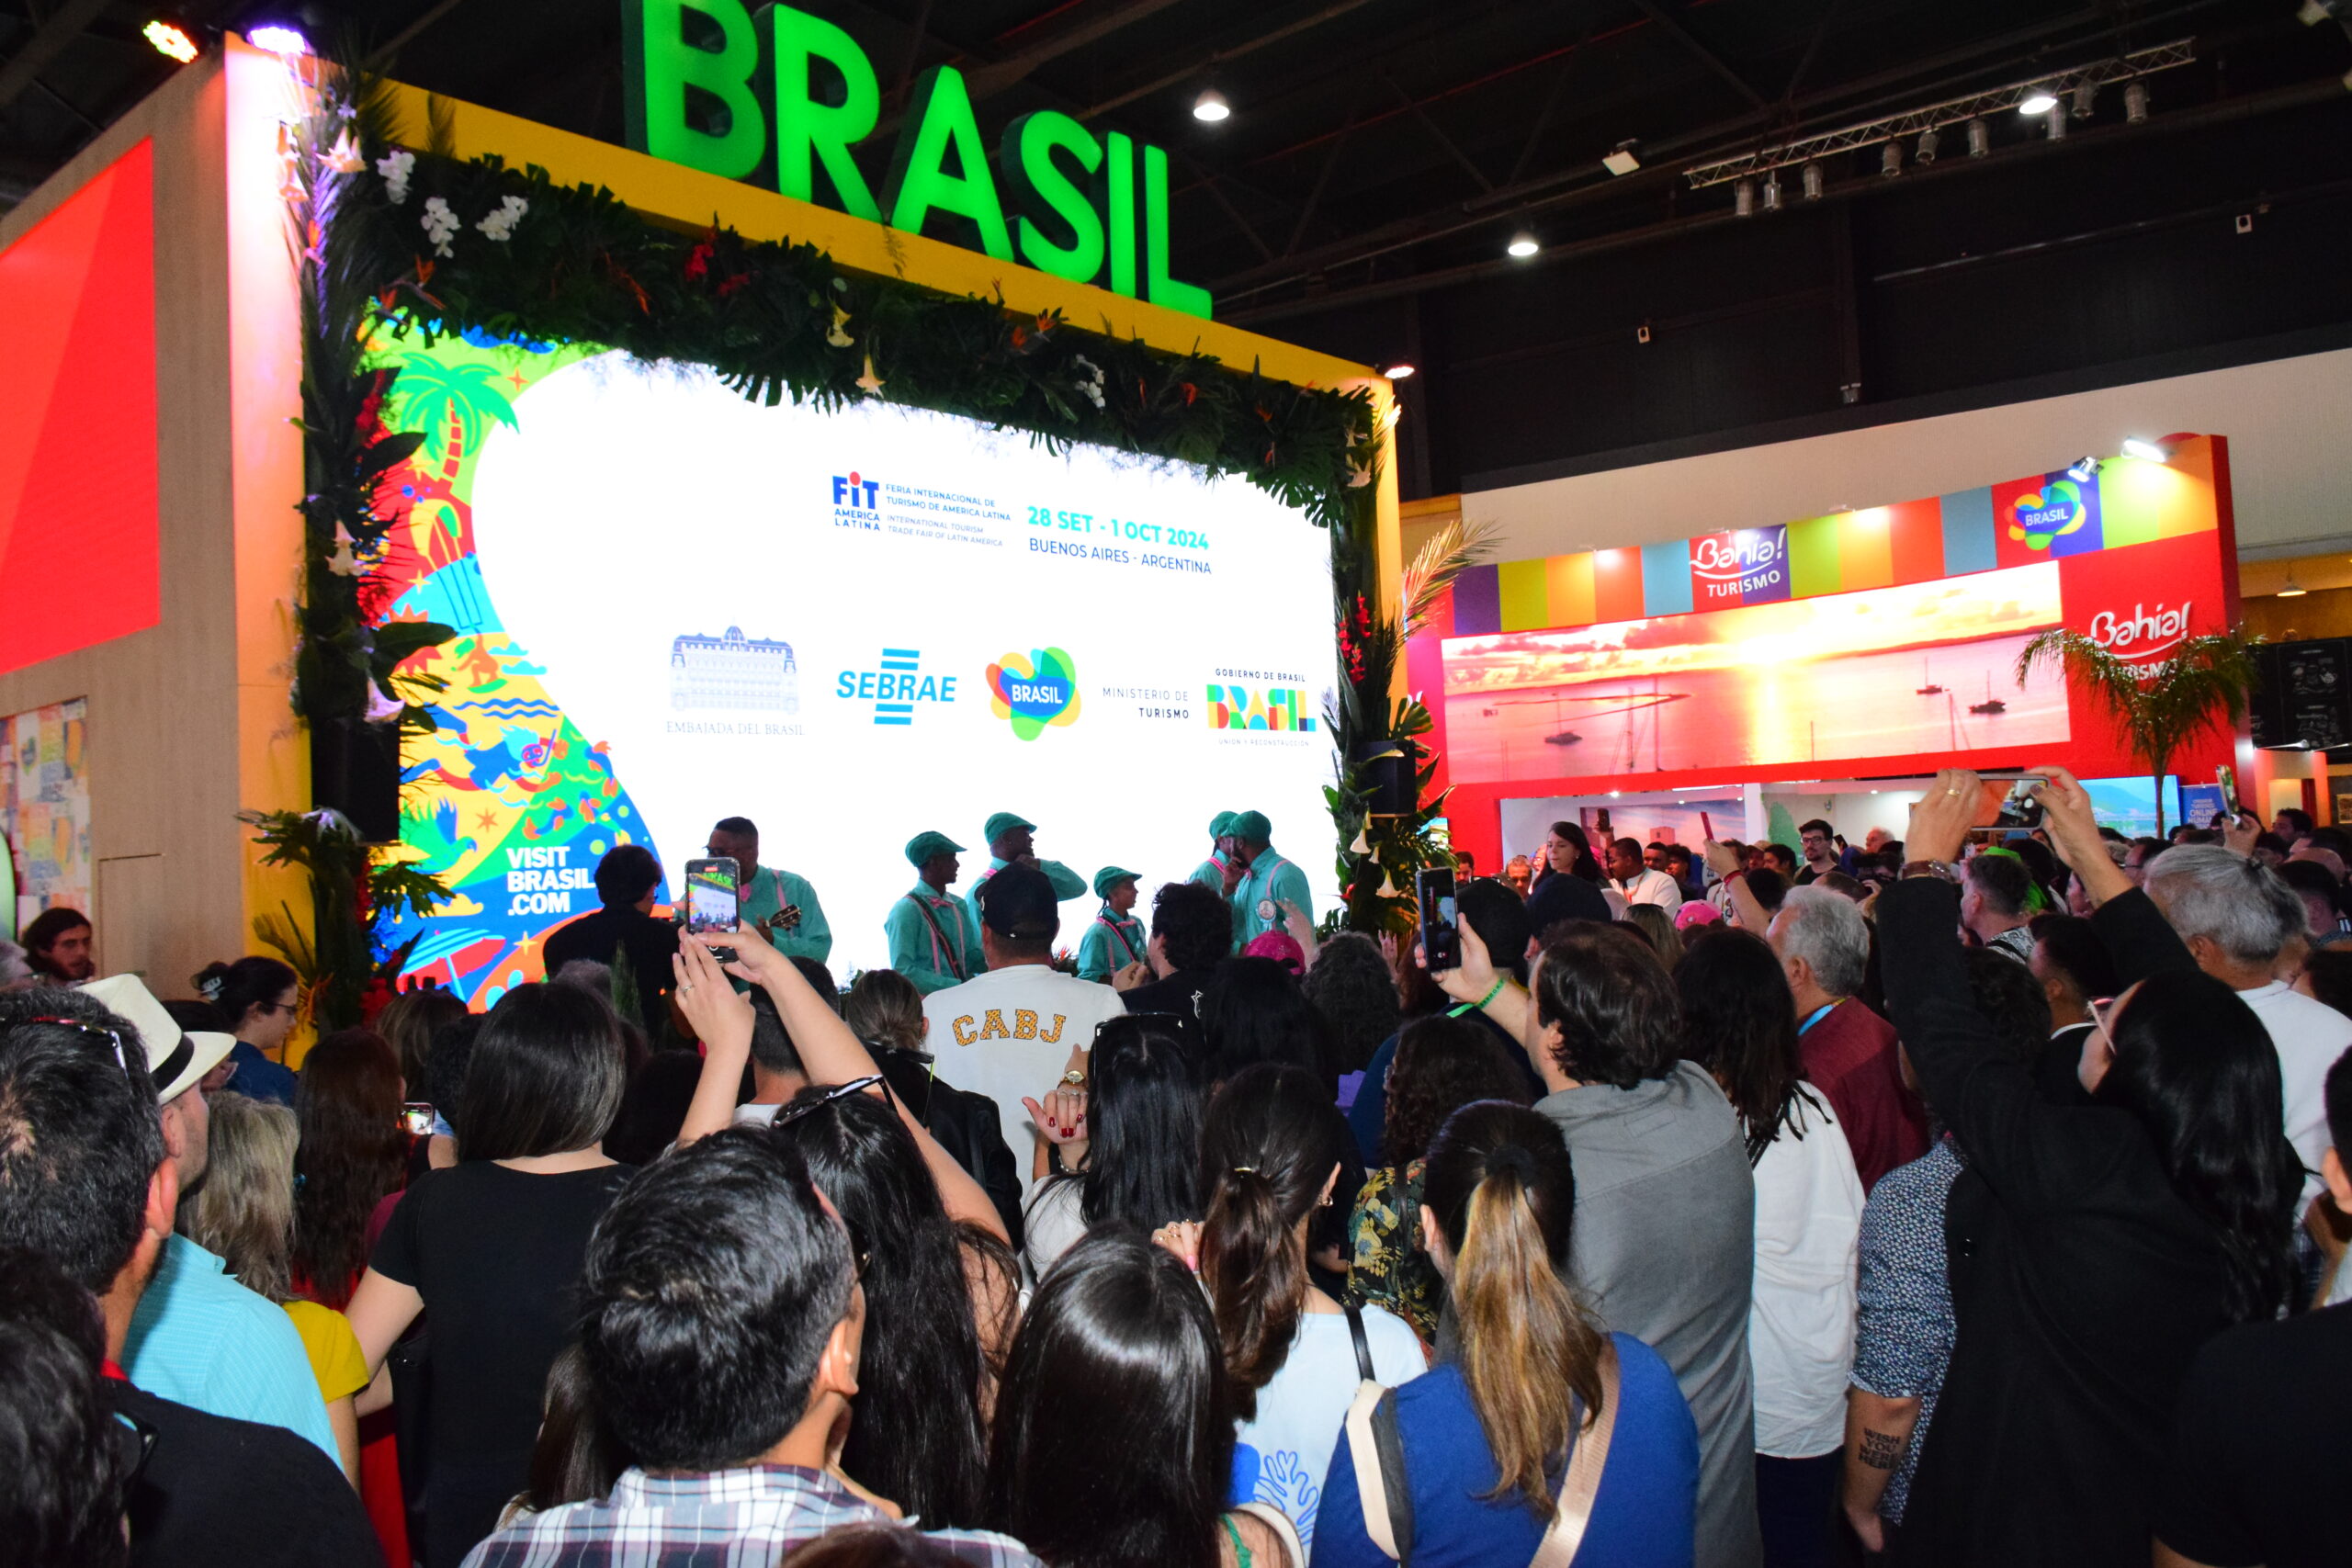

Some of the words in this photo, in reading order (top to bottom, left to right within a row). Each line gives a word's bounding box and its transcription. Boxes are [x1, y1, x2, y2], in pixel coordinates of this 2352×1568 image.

[640, 0, 1213, 320] BRASIL
[886, 483, 911, 495] FERIA
[913, 489, 982, 506] INTERNACIONAL
[984, 499, 996, 508] DE
[834, 508, 880, 522] AMERICA
[887, 496, 926, 509] TURISMO
[929, 502, 940, 511] DE
[943, 504, 980, 517] AMERICA
[982, 511, 1011, 522] LATINA
[2025, 508, 2069, 527] BRASIL
[835, 518, 881, 532] LATINA
[888, 514, 948, 530] INTERNATIONAL
[951, 523, 984, 534] TOURISM
[888, 525, 914, 536] TRADE
[916, 529, 933, 537] FAIR
[947, 534, 968, 542] LATIN
[970, 536, 1003, 547] AMERICA
[1027, 505, 1052, 527] 28
[1057, 511, 1093, 534] SET
[1111, 519, 1119, 537] 1
[1125, 521, 1162, 543] OCT
[1167, 527, 1209, 551] 2024
[1029, 537, 1088, 558] BUENOS
[1091, 547, 1130, 563] AIRES
[1141, 554, 1213, 575] ARGENTINA
[1689, 526, 1786, 570] Bahia!
[1706, 570, 1781, 598] TURISMO
[2090, 601, 2192, 649] Bahia!
[836, 671, 956, 703] SEBRAE
[1216, 668, 1261, 680] GOBIERNO
[1264, 671, 1274, 680] DE
[1277, 672, 1306, 682] BRASIL
[1012, 684, 1063, 705] BRASIL
[1102, 687, 1170, 701] MINISTERIO
[1175, 691, 1189, 702] DE
[1139, 707, 1190, 719] TURISMO
[1206, 683, 1317, 732] BRASIL
[666, 720, 736, 735] EMBAJADA
[738, 722, 762, 735] DEL
[764, 723, 806, 736] BRASIL
[505, 846, 571, 869] VISIT
[507, 868, 596, 893] BRASIL
[507, 892, 571, 917] .COM
[952, 1009, 1067, 1047] CABJ
[1863, 1427, 1901, 1445] WISH
[1866, 1438, 1898, 1453] YOU
